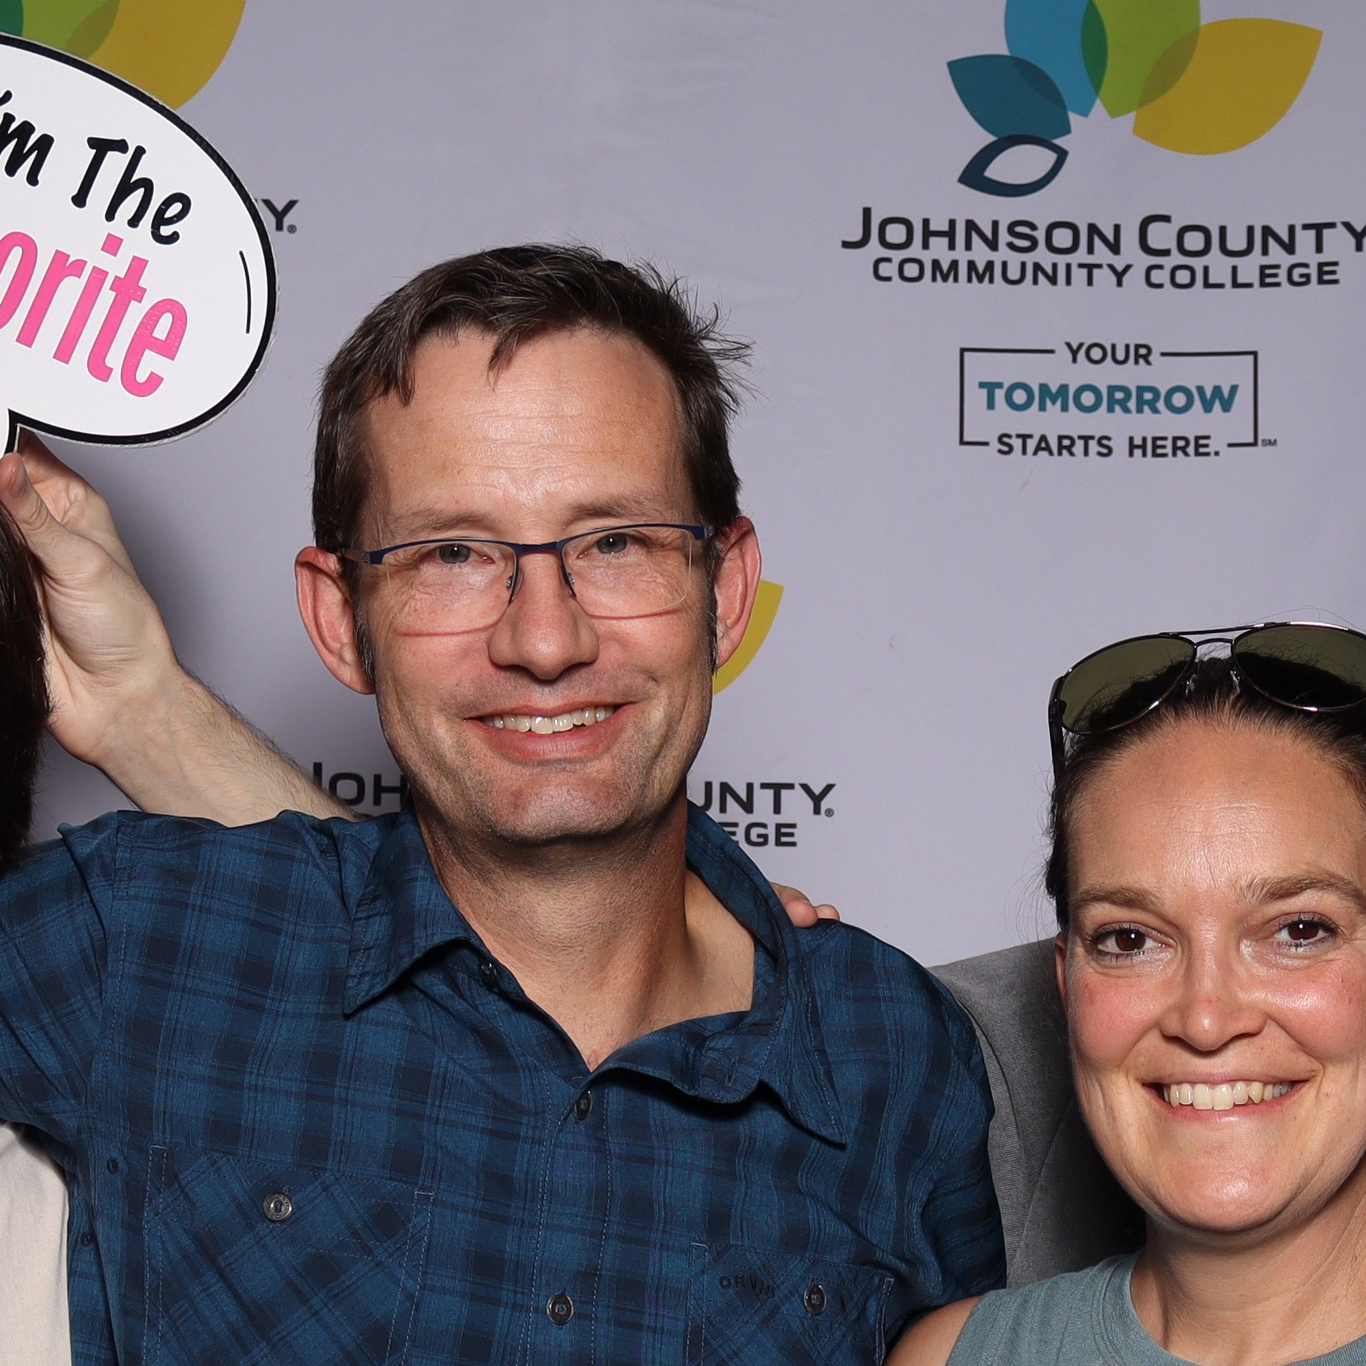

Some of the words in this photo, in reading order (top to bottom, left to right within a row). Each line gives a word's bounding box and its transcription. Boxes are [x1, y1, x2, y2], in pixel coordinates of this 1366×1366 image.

[71, 136, 191, 244] The
[841, 207, 1122, 256] JOHNSON
[872, 256, 1134, 288] COMMUNITY
[1144, 260, 1341, 289] COLLEGE
[1064, 341, 1153, 366] YOUR
[978, 381, 1240, 414] TOMORROW
[996, 433, 1113, 458] STARTS
[1128, 435, 1220, 459] HERE.
